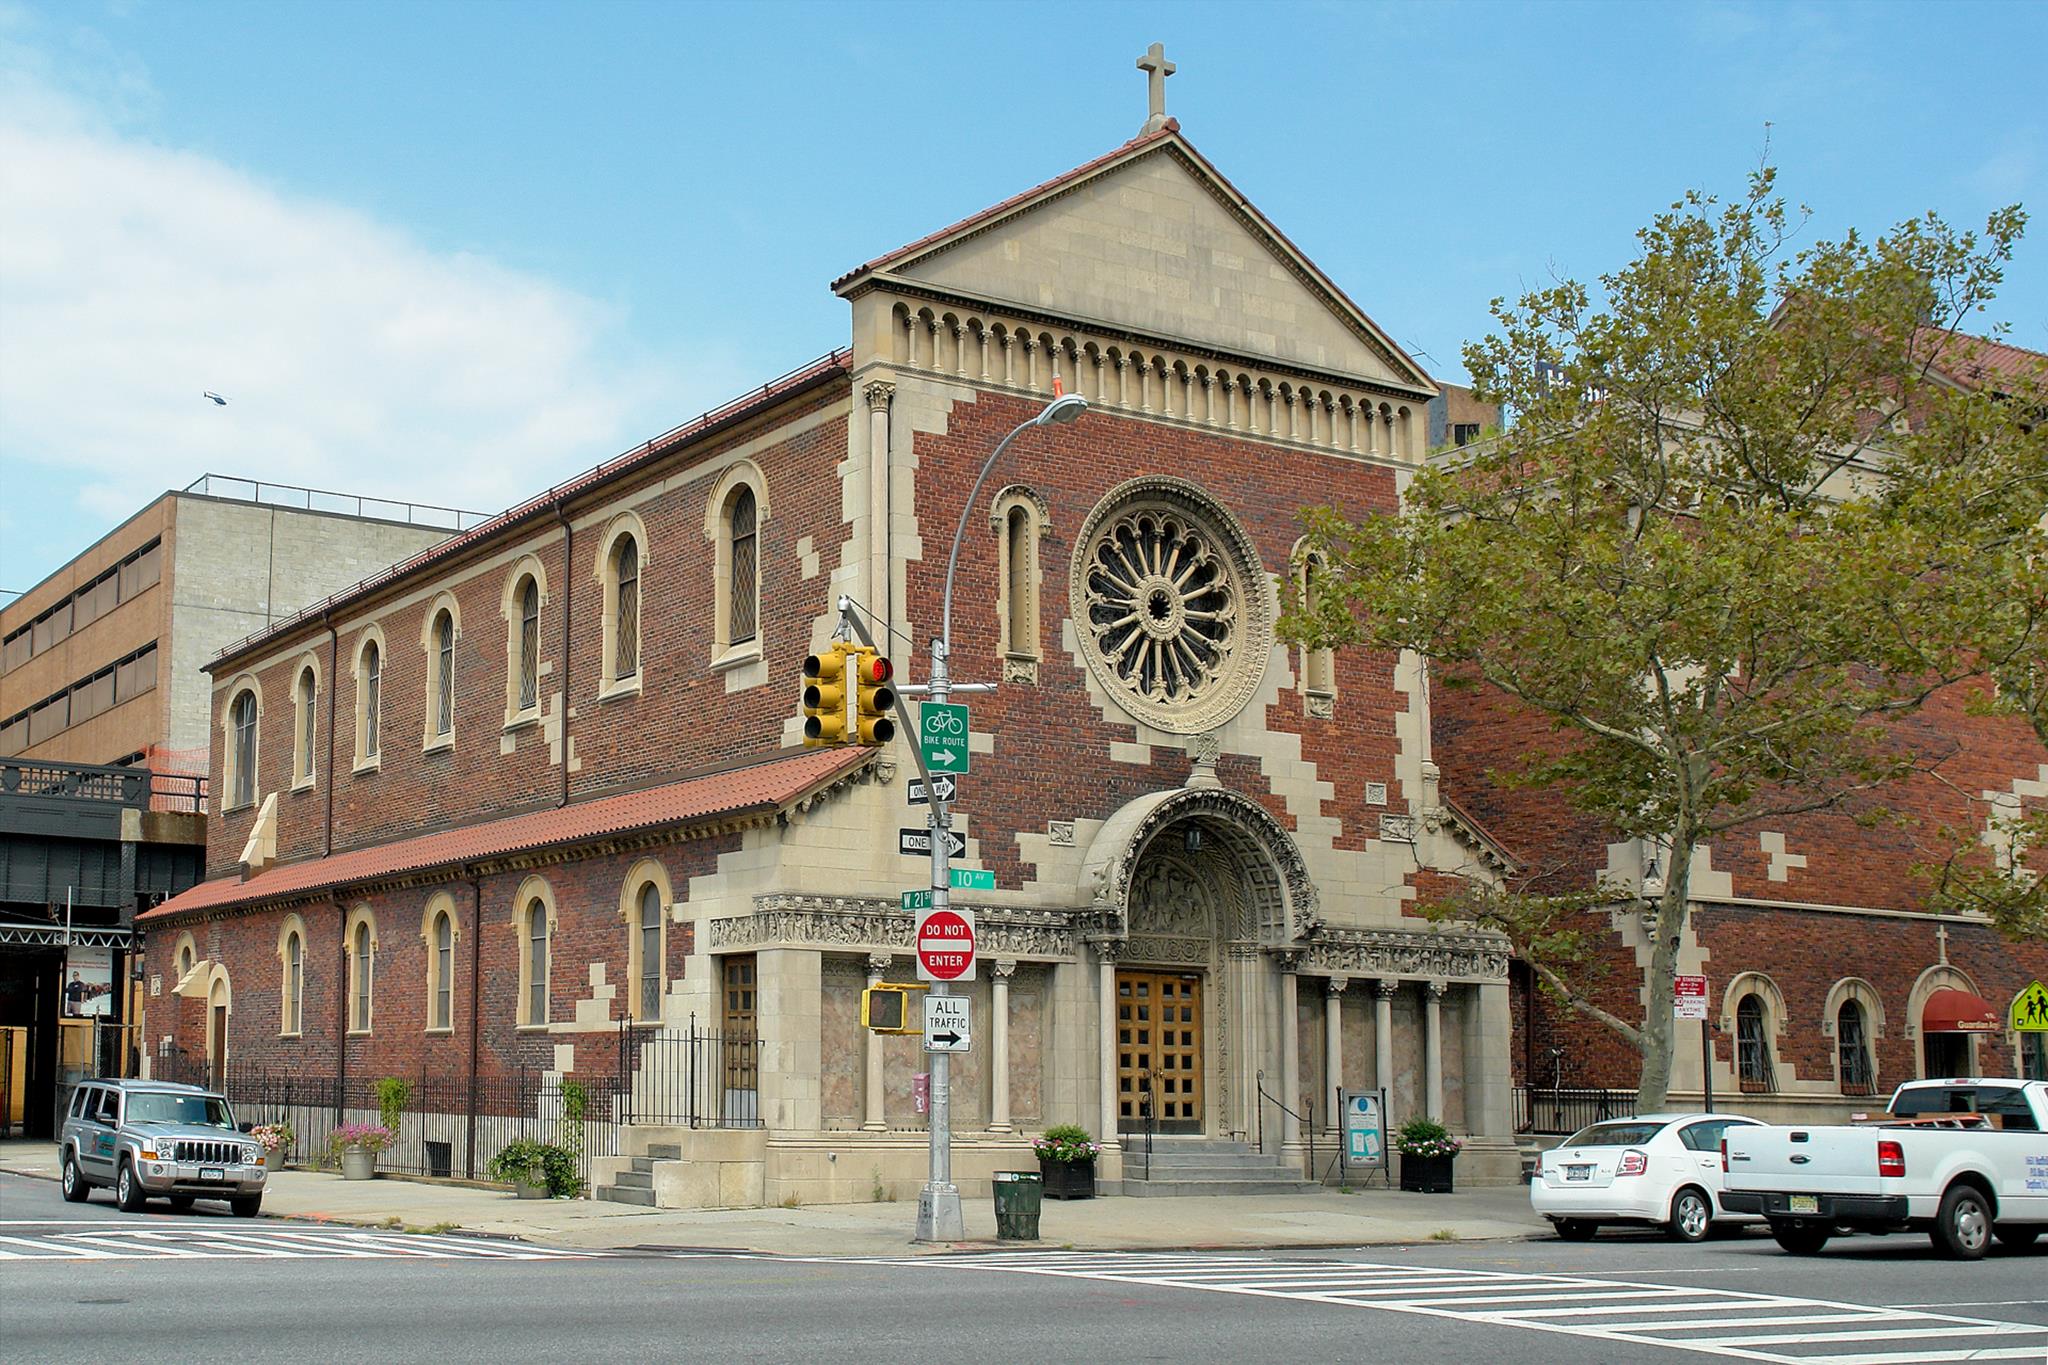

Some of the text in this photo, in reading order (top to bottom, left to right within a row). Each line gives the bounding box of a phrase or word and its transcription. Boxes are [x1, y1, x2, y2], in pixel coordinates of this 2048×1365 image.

[924, 735, 965, 747] BIKE ROUTE
[936, 783, 951, 795] WAY
[908, 836, 958, 850] ONE AY
[958, 871, 972, 887] 10
[904, 891, 931, 908] W 21 ST
[926, 925, 965, 936] DO NOT
[929, 955, 963, 967] ENTER
[935, 1001, 961, 1014] ALL
[929, 1017, 966, 1029] TRAFFIC
[1957, 1020, 1987, 1029] Guardian
